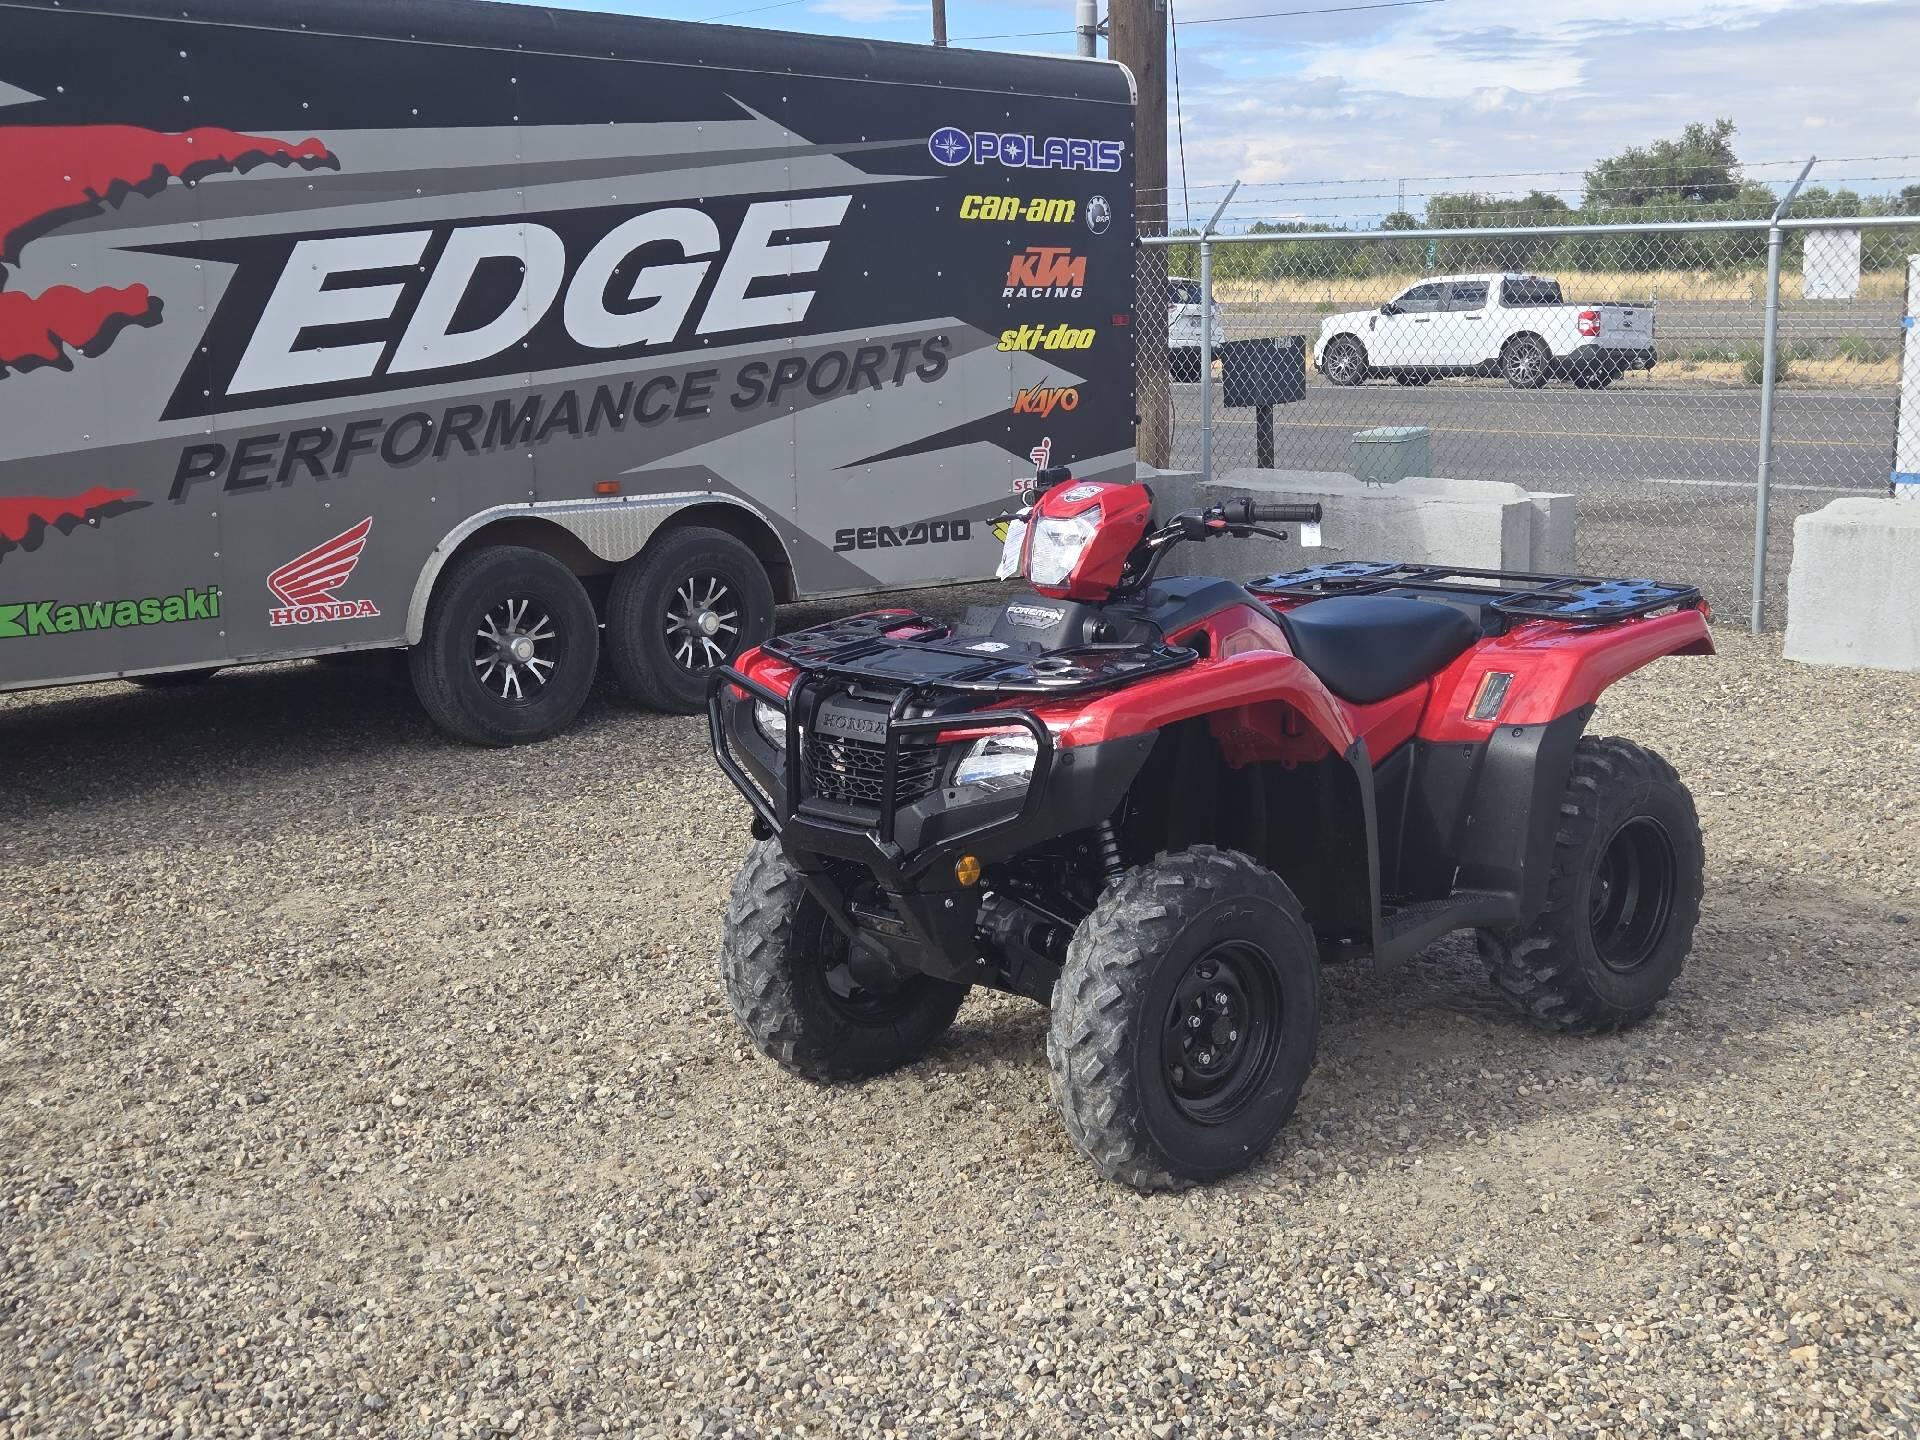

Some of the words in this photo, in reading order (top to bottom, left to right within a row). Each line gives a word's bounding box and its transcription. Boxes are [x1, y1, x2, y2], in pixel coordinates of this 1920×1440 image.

[974, 131, 1124, 172] POLARIS
[1006, 247, 1087, 287] KTM
[225, 195, 853, 396] EDGE
[1002, 287, 1083, 298] RACING
[997, 323, 1096, 351] ski-doo
[1013, 382, 1079, 418] KAYO
[167, 369, 717, 503] PERFORMANCE
[728, 335, 951, 411] SPORTS
[24, 585, 219, 636] Kawasaki
[269, 599, 381, 627] HONDA
[1006, 606, 1065, 621] FOREMAN
[822, 712, 887, 736] HONDA
